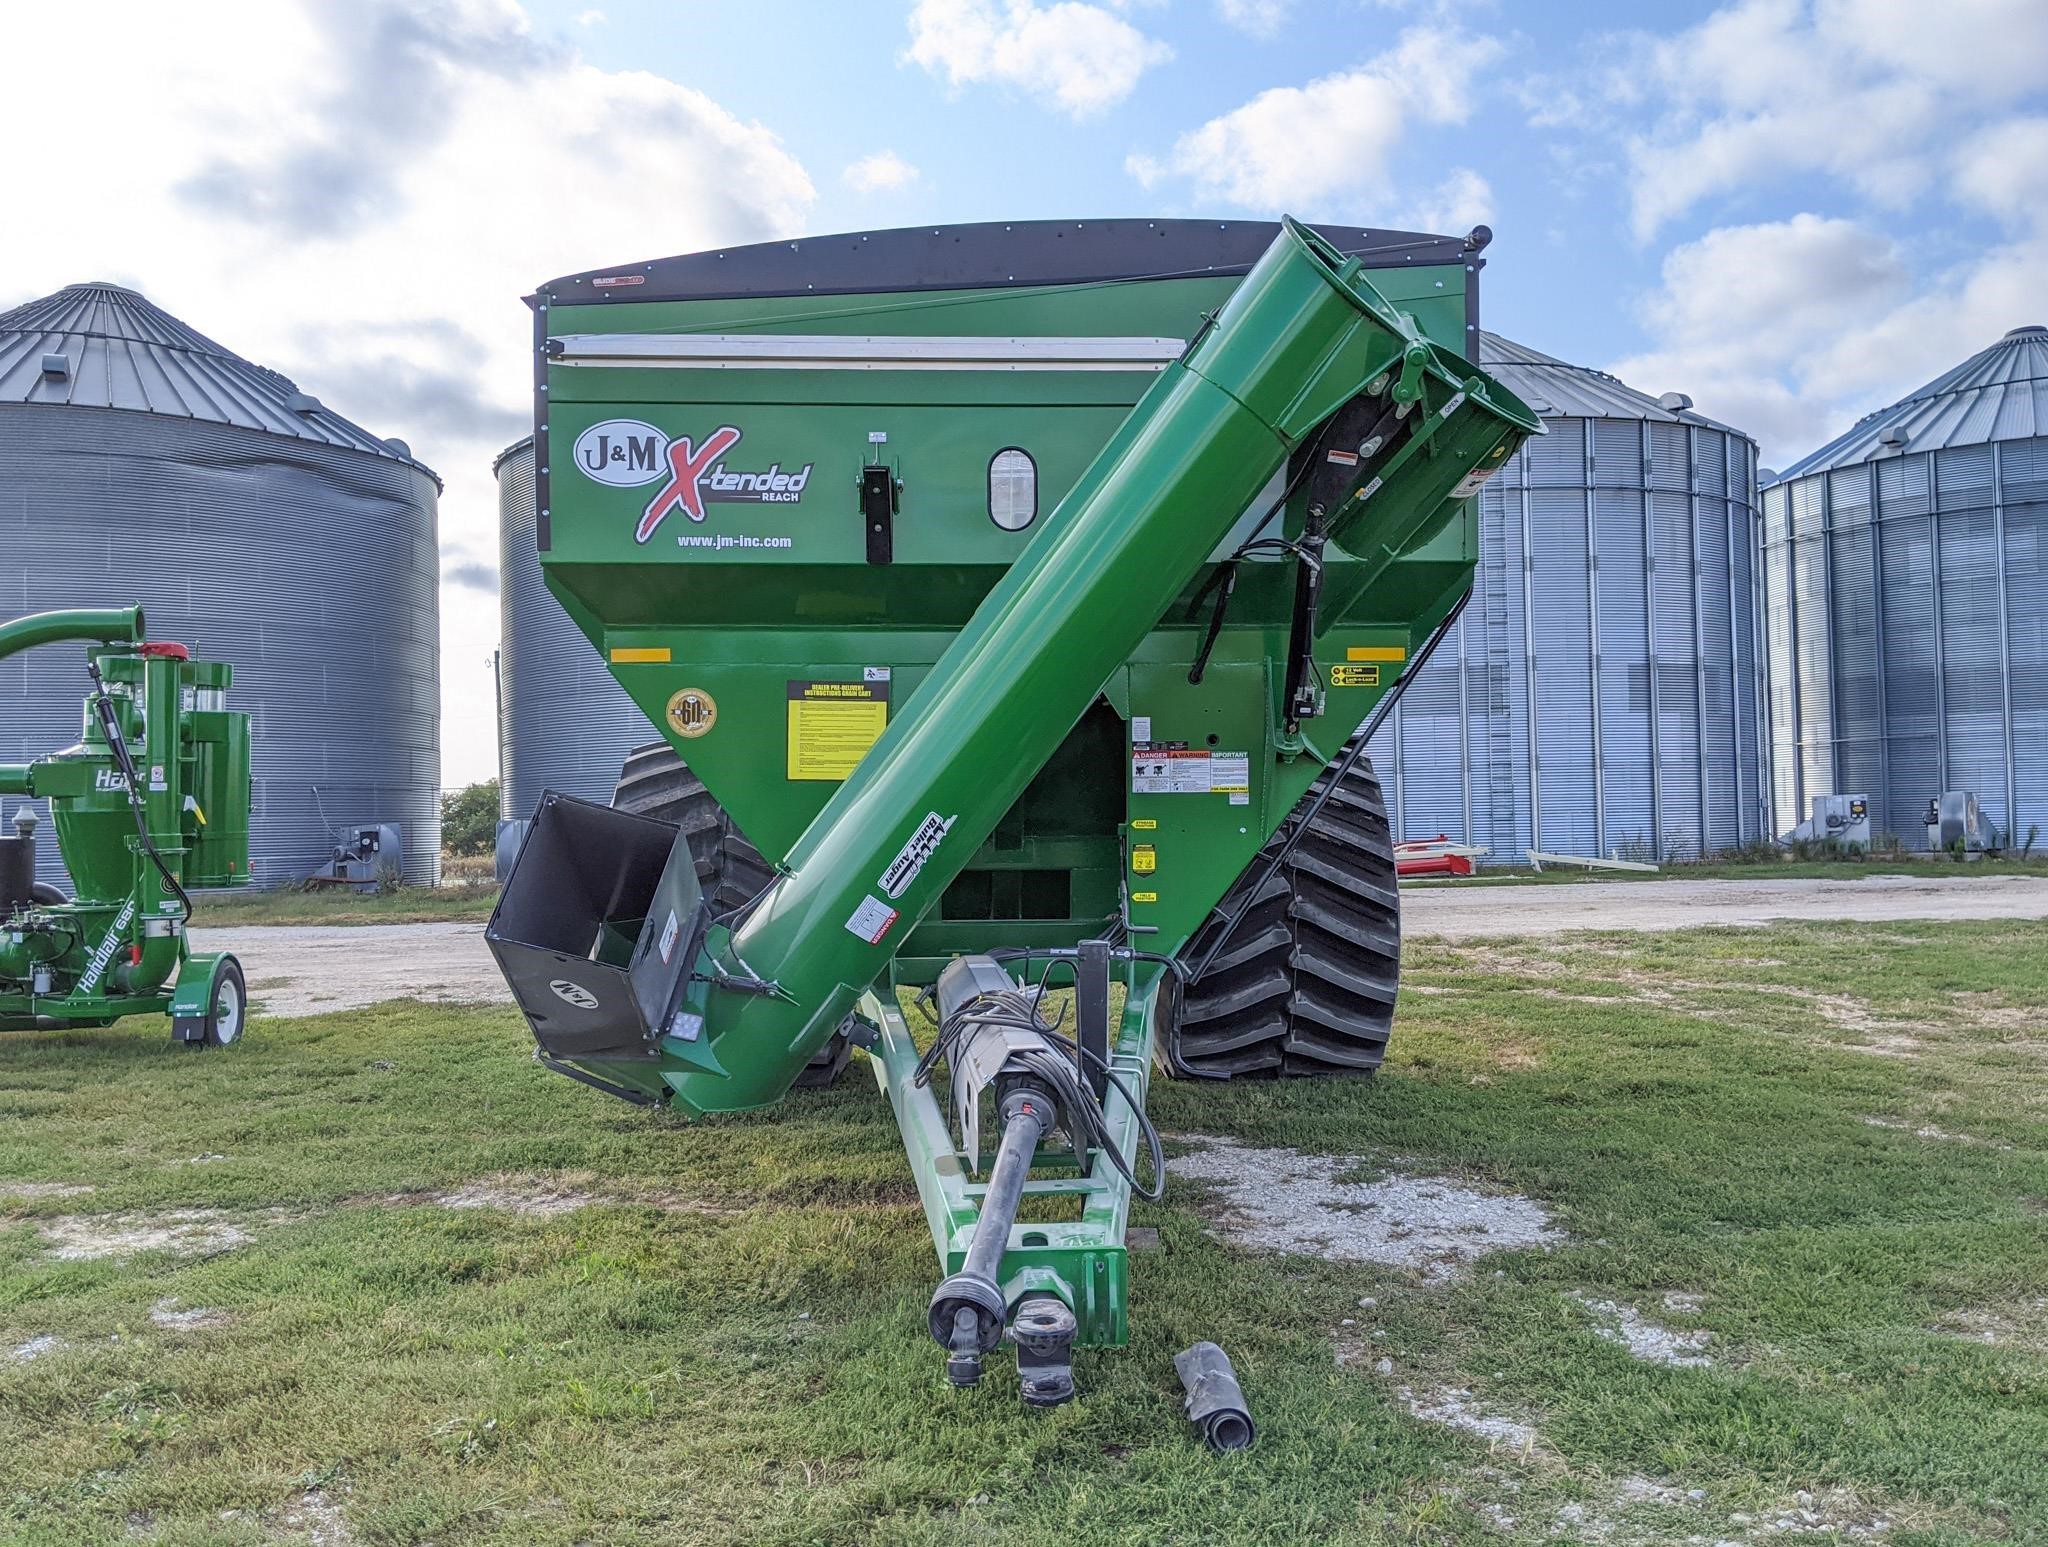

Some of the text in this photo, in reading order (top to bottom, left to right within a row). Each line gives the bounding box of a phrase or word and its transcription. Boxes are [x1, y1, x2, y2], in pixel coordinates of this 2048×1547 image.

[1444, 398, 1460, 414] OPEN
[1363, 478, 1381, 498] CLOSED
[761, 492, 799, 502] REACH
[677, 534, 792, 551] www.jm-inc.com
[883, 815, 938, 888] Bullet Auger
